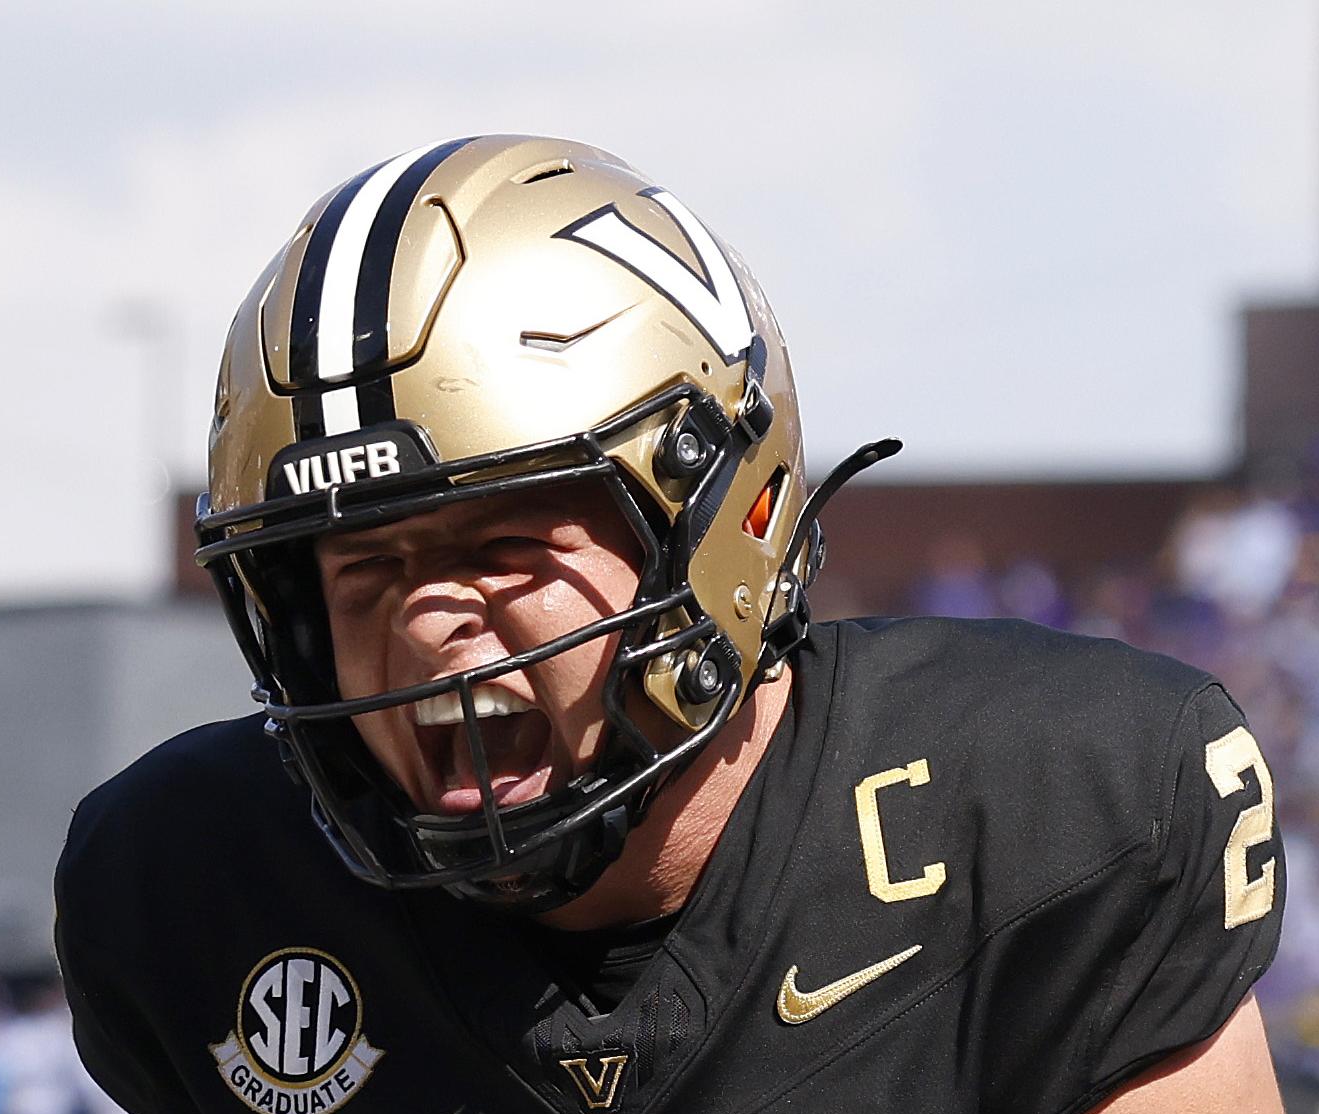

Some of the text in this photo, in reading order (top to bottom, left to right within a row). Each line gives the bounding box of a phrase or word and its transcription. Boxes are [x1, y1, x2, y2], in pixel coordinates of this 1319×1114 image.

[552, 185, 755, 366] V
[283, 439, 401, 496] VUFB
[855, 758, 947, 903] C
[1205, 726, 1275, 930] 2
[248, 958, 350, 1076] SEC
[559, 1053, 630, 1110] V
